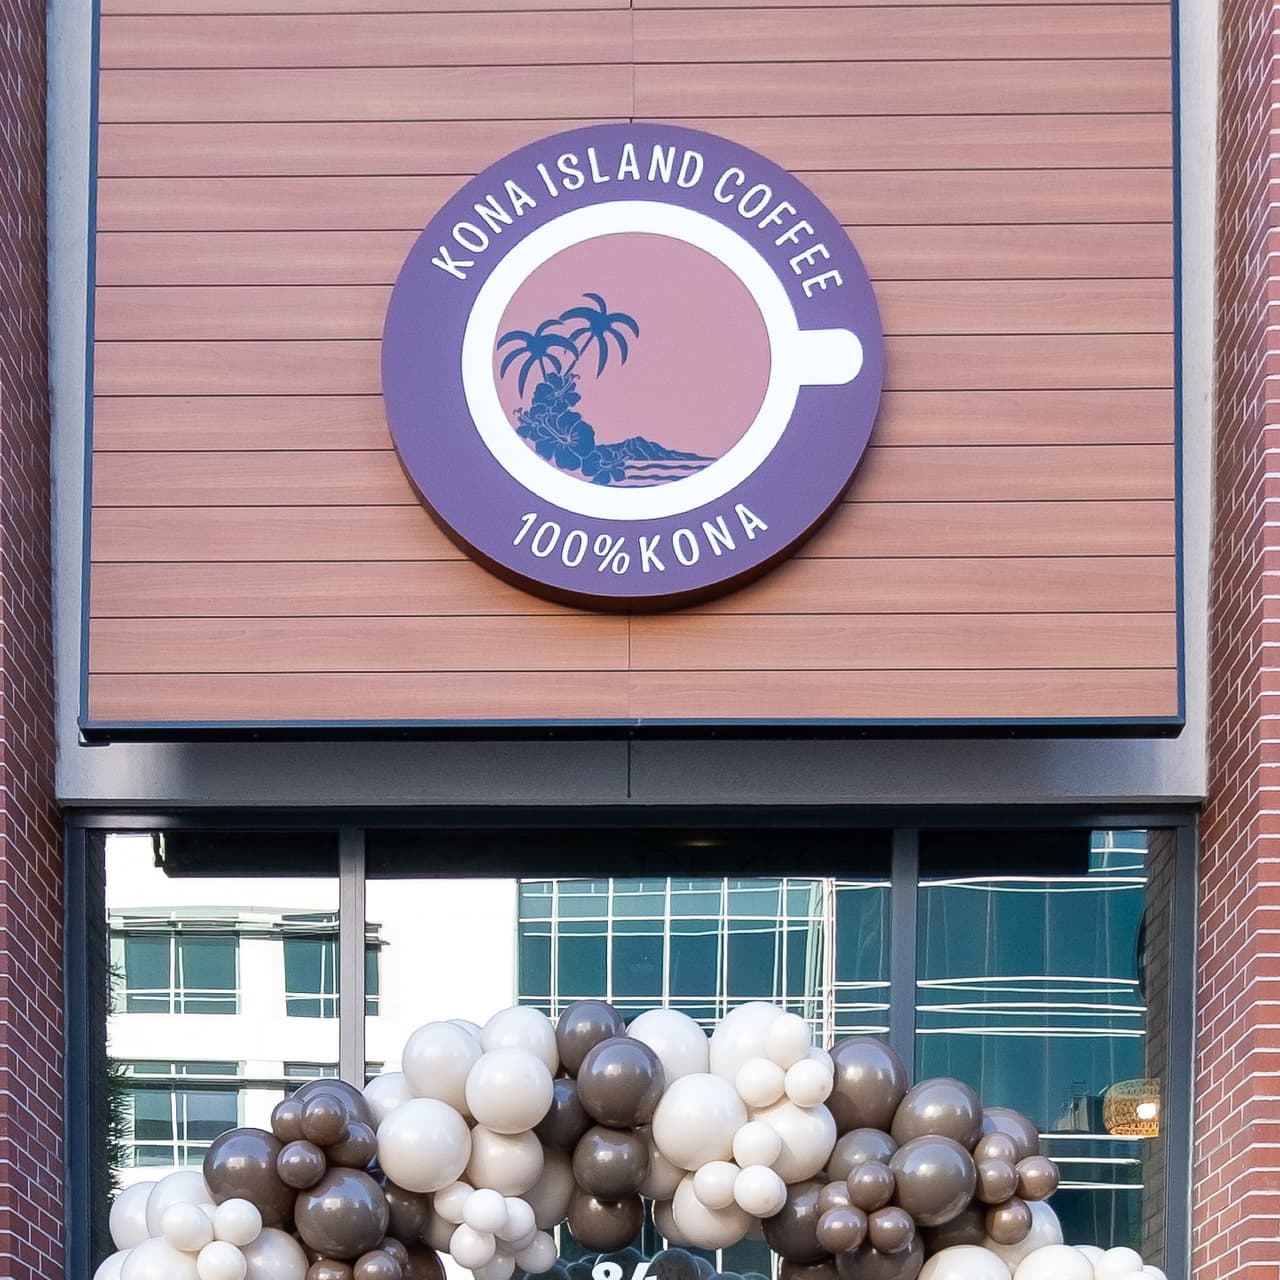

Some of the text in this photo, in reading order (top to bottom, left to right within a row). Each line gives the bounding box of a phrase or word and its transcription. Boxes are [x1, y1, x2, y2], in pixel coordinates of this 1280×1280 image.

[431, 143, 843, 298] KONA ISLAND COFFEE
[513, 503, 768, 575] 100% KONA
